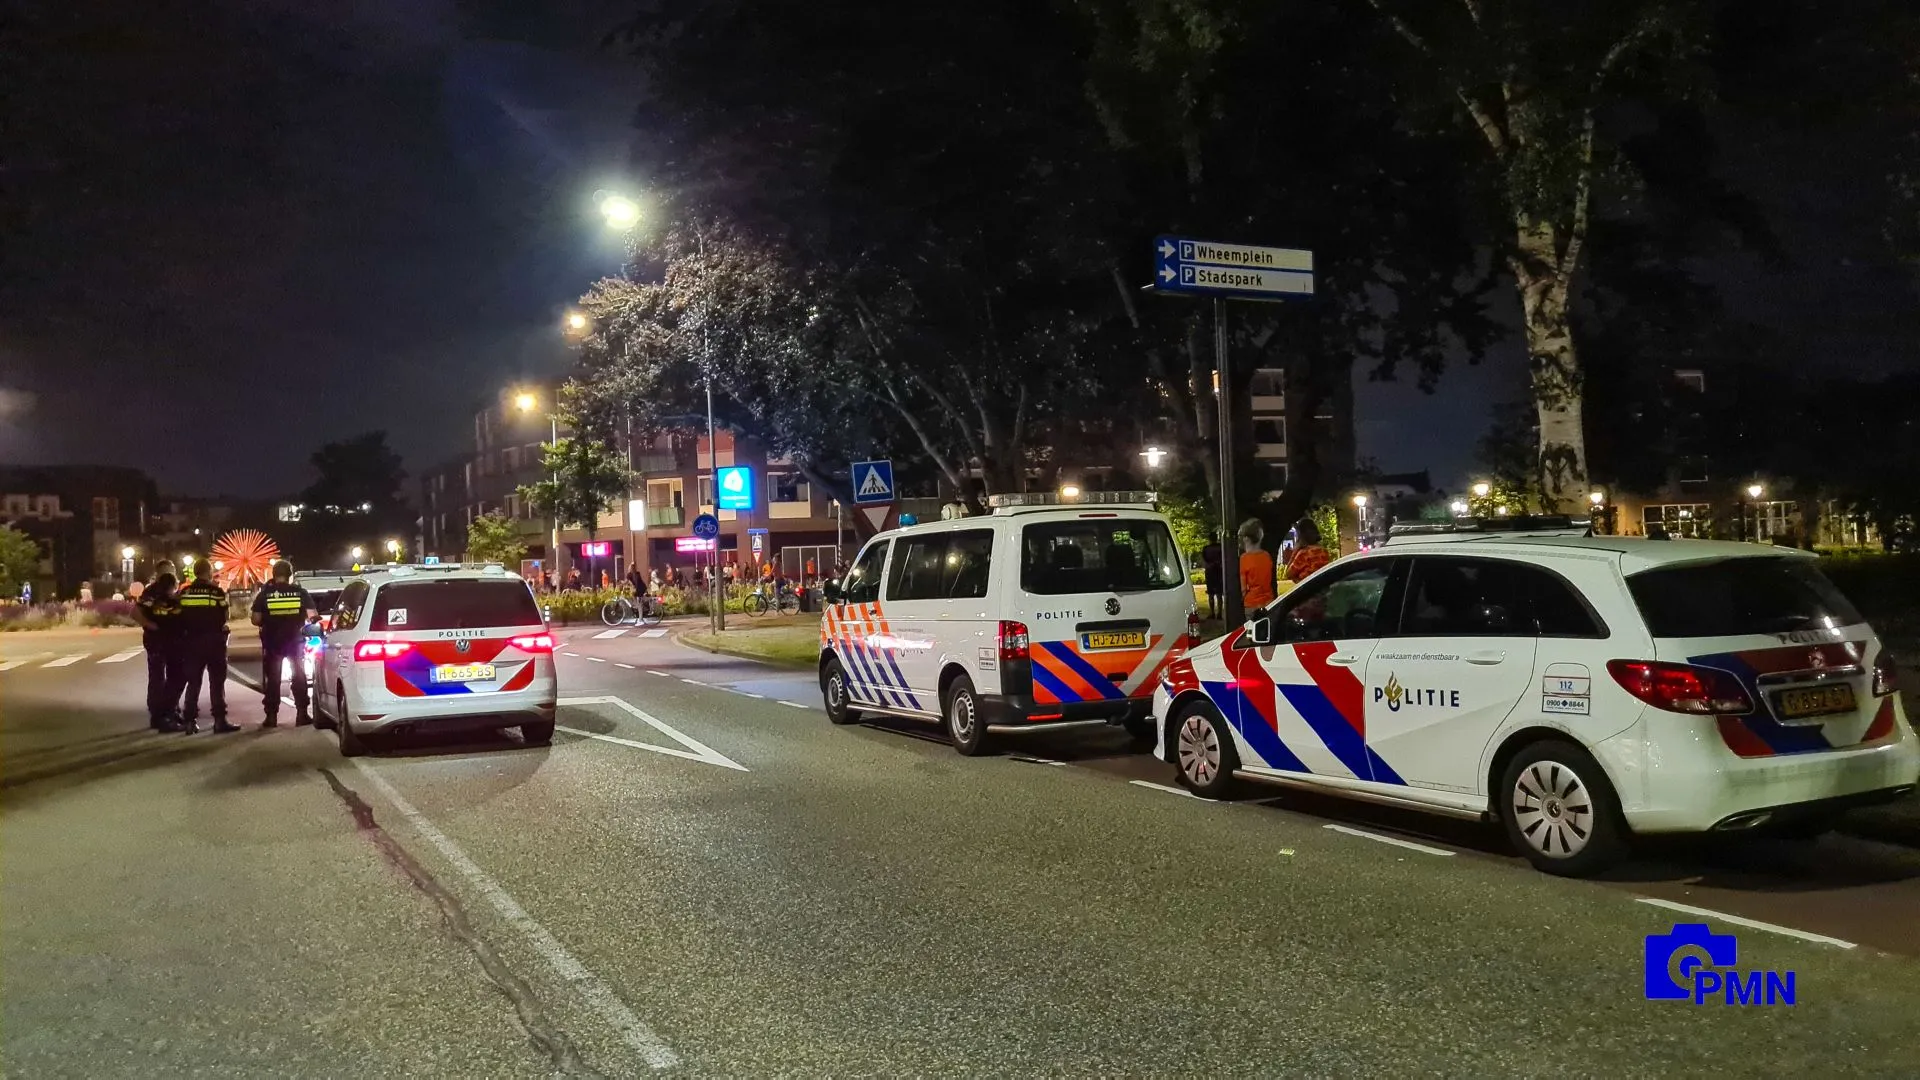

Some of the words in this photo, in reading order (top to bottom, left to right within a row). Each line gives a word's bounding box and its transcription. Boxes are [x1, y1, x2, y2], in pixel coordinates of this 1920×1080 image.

[1197, 246, 1273, 264] Wheemplein
[1198, 270, 1263, 287] Stadspark
[1036, 610, 1083, 620] POLITIE
[438, 630, 486, 638] POLITIE
[1092, 632, 1138, 646] HJ-270-P
[1421, 653, 1455, 661] dienstbaar
[1559, 681, 1573, 690] 112
[1374, 686, 1460, 712] POLITIE
